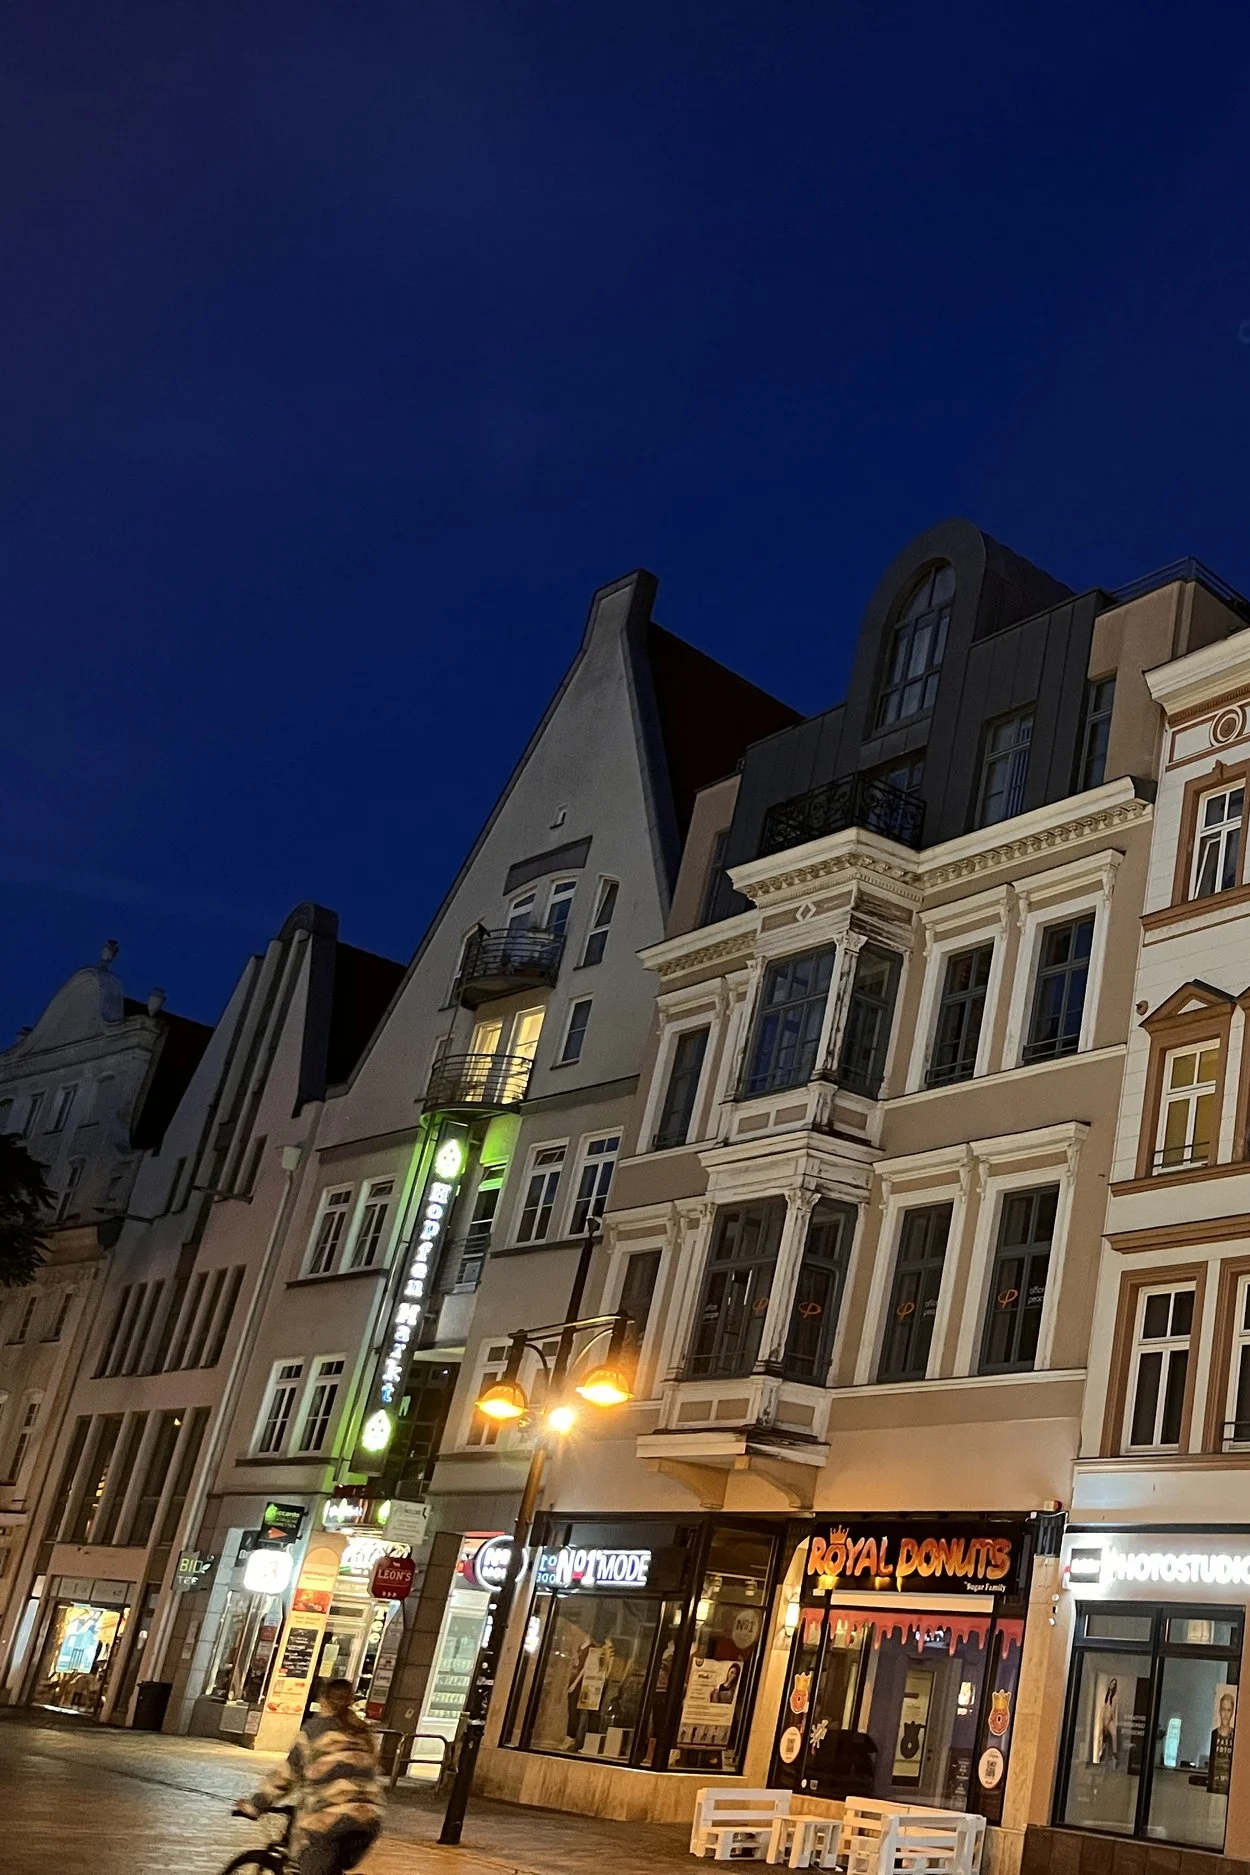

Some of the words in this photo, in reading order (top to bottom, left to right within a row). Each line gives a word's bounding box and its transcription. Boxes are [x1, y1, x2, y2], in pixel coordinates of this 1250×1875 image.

[597, 1553, 651, 1582] MODE
[807, 1536, 893, 1577] ROYAL
[896, 1537, 1012, 1580] DONUTS
[377, 1569, 412, 1582] LEON'S
